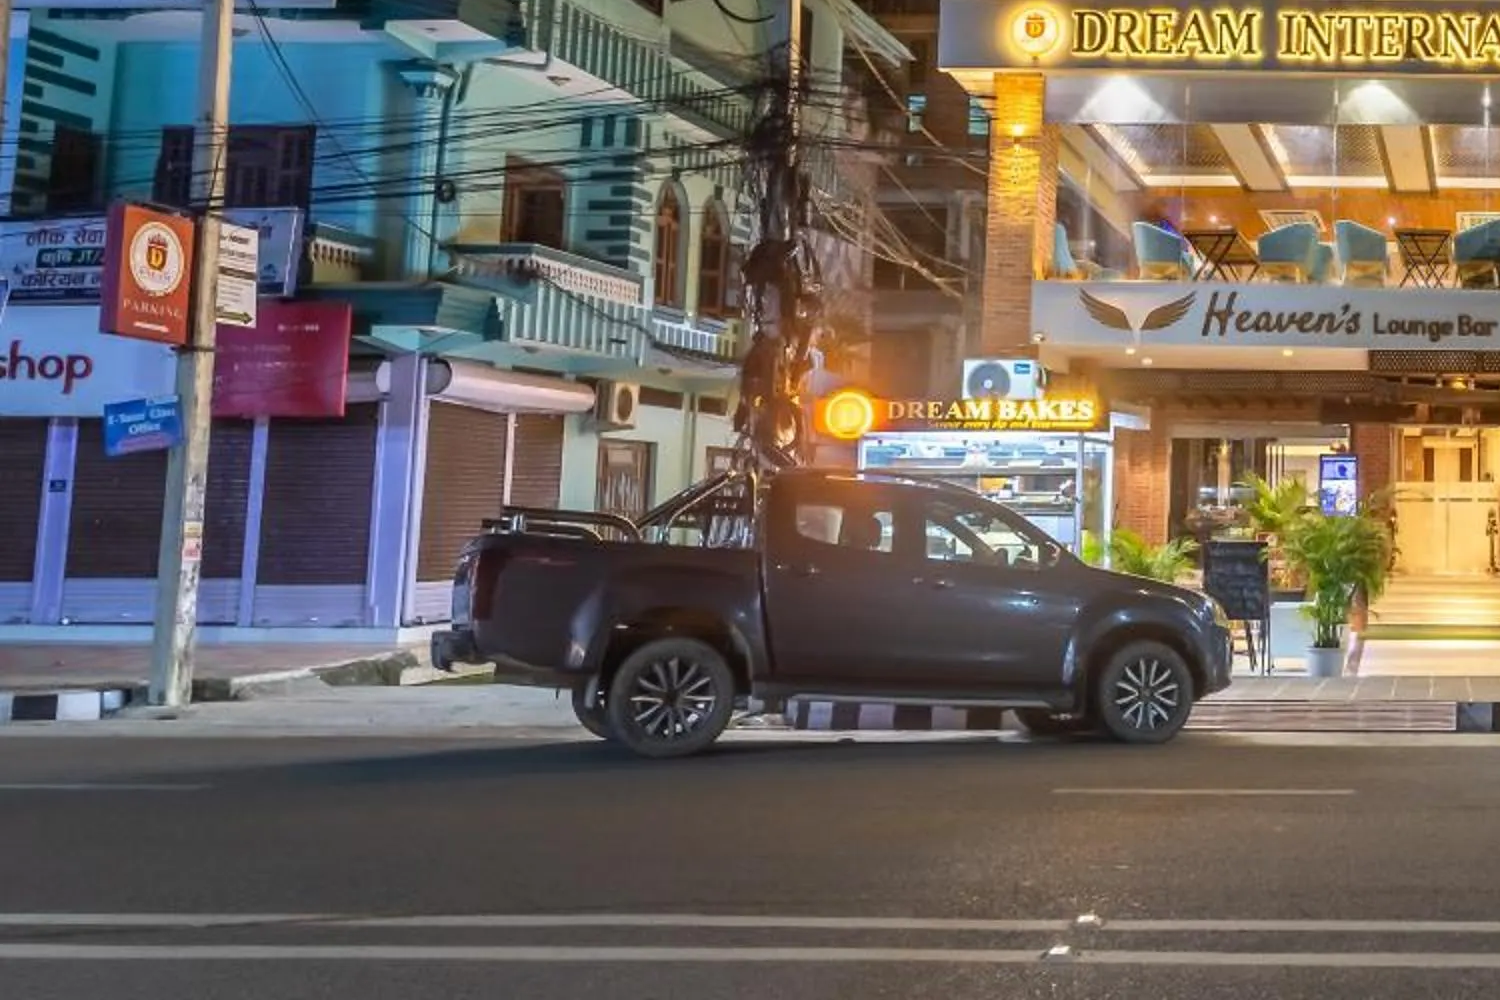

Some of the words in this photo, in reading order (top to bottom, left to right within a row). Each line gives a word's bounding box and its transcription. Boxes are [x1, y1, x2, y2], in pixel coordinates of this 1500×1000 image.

[1071, 9, 1260, 56] DREAM
[1201, 291, 1361, 336] Heaven's
[1374, 312, 1453, 342] Lounge
[1458, 313, 1498, 336] Bar
[888, 401, 991, 420] DREAM
[998, 400, 1095, 420] BAKES
